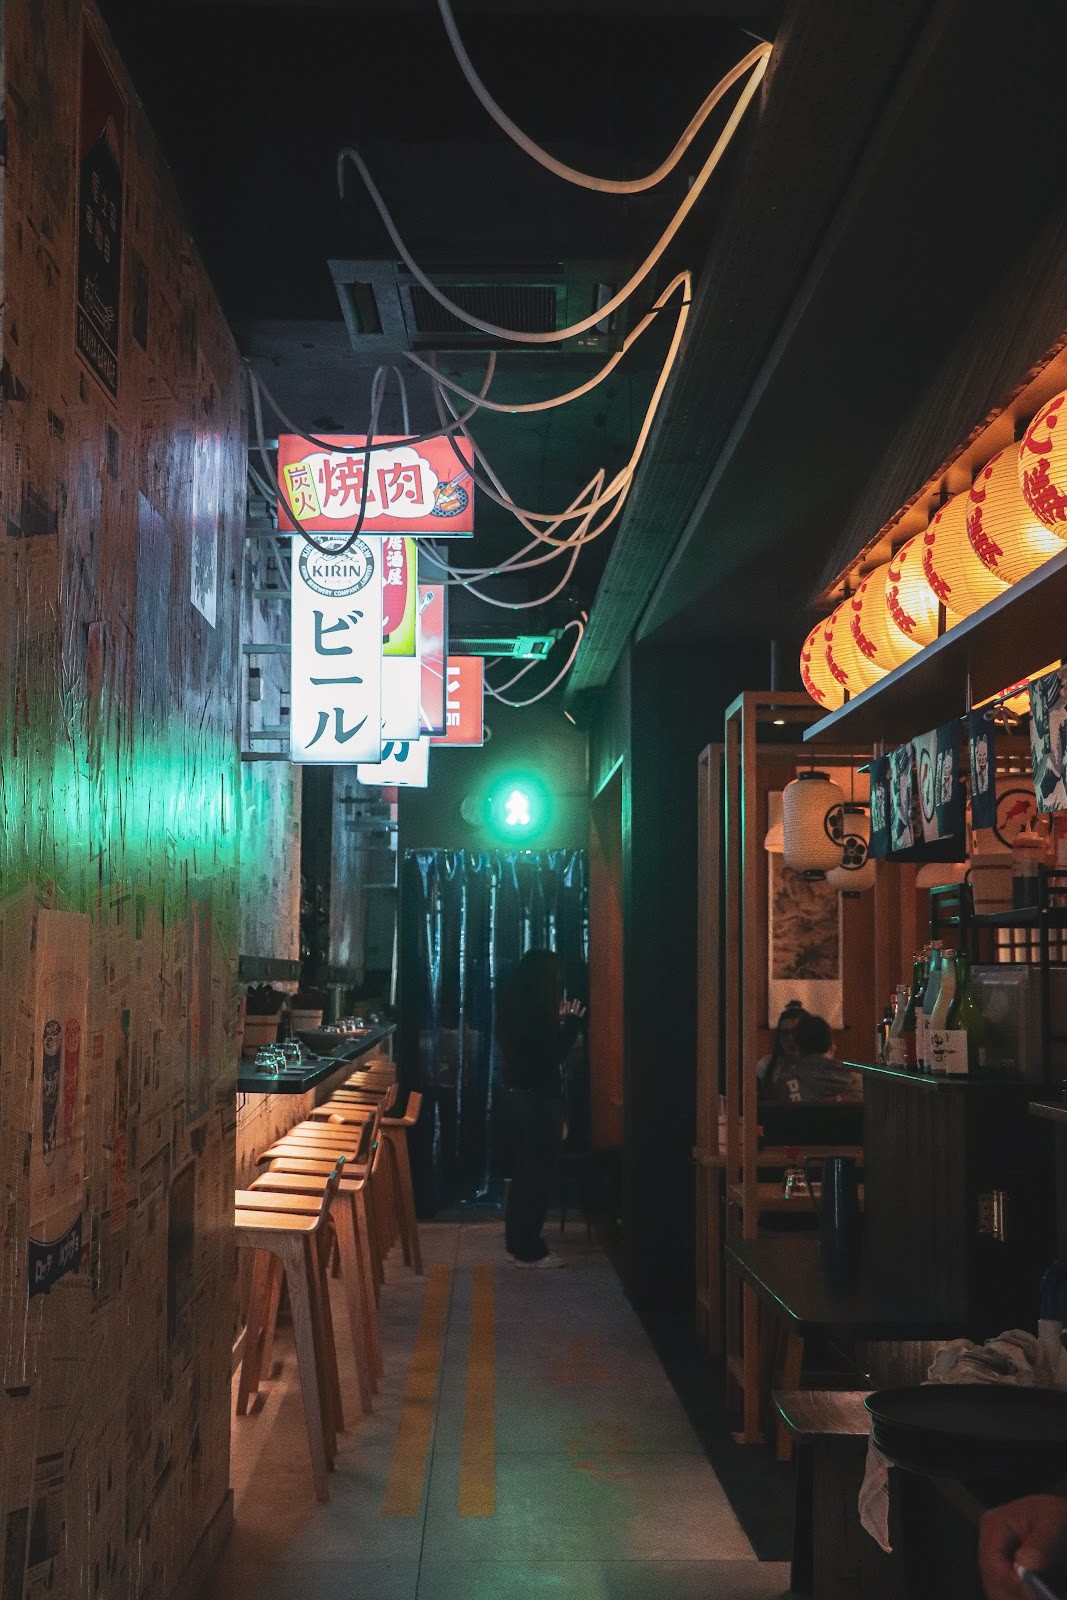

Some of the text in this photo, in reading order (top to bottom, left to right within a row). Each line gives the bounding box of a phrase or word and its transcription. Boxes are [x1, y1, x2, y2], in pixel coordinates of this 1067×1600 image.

[287, 464, 317, 516] 炭火
[318, 457, 424, 509] 焼肉
[312, 565, 361, 577] KIRIN
[354, 538, 372, 558] BREW
[386, 537, 403, 586] 居酒屋
[334, 585, 360, 596] COMPANY
[304, 610, 368, 750] ビール
